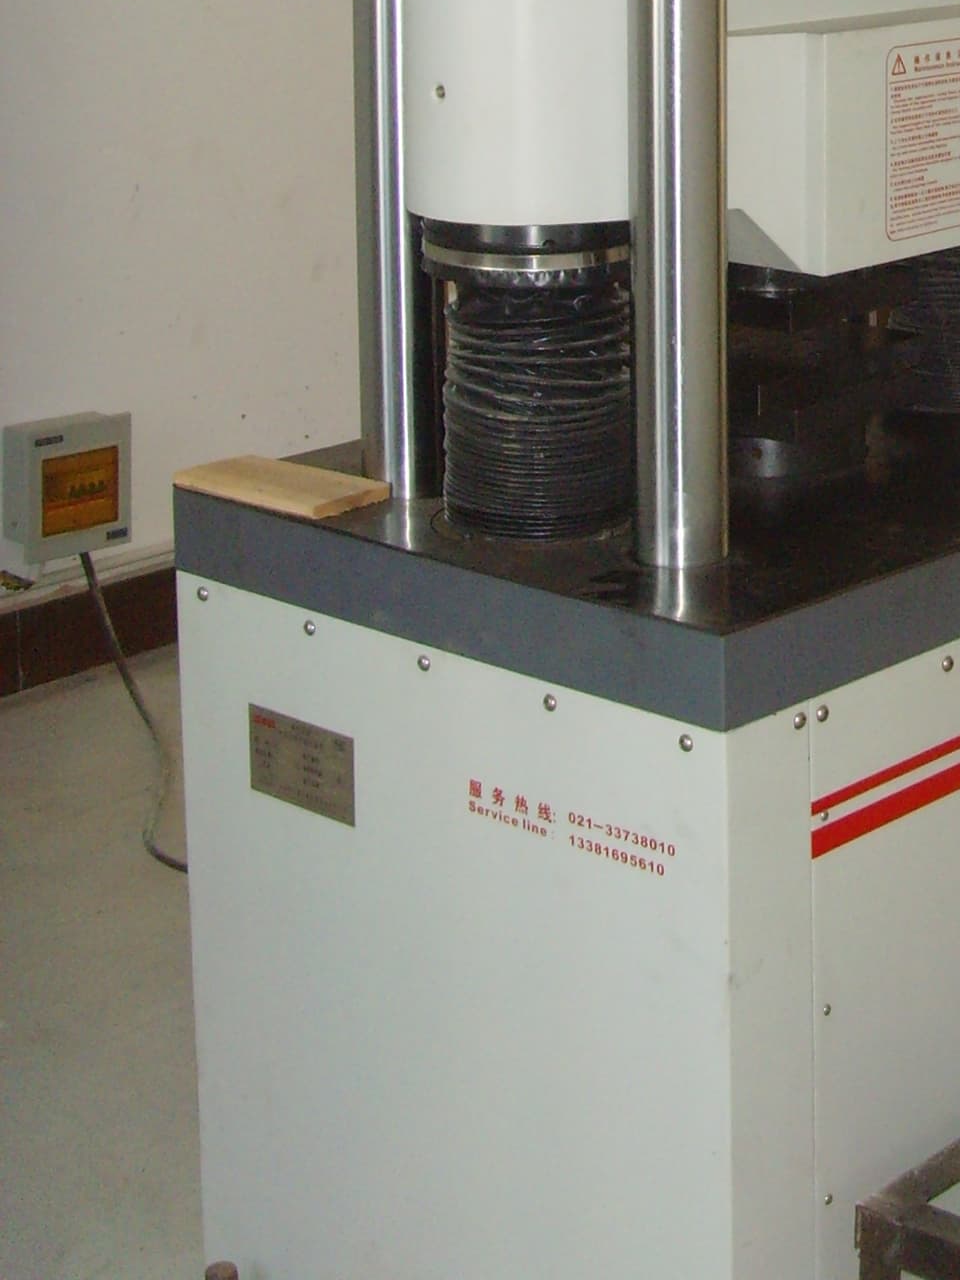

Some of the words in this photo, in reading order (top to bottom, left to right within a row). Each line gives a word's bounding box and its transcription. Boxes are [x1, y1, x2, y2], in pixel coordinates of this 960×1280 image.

[468, 801, 519, 827] Service
[568, 835, 665, 876] 13381695610
[568, 811, 676, 857] 021-33738010
